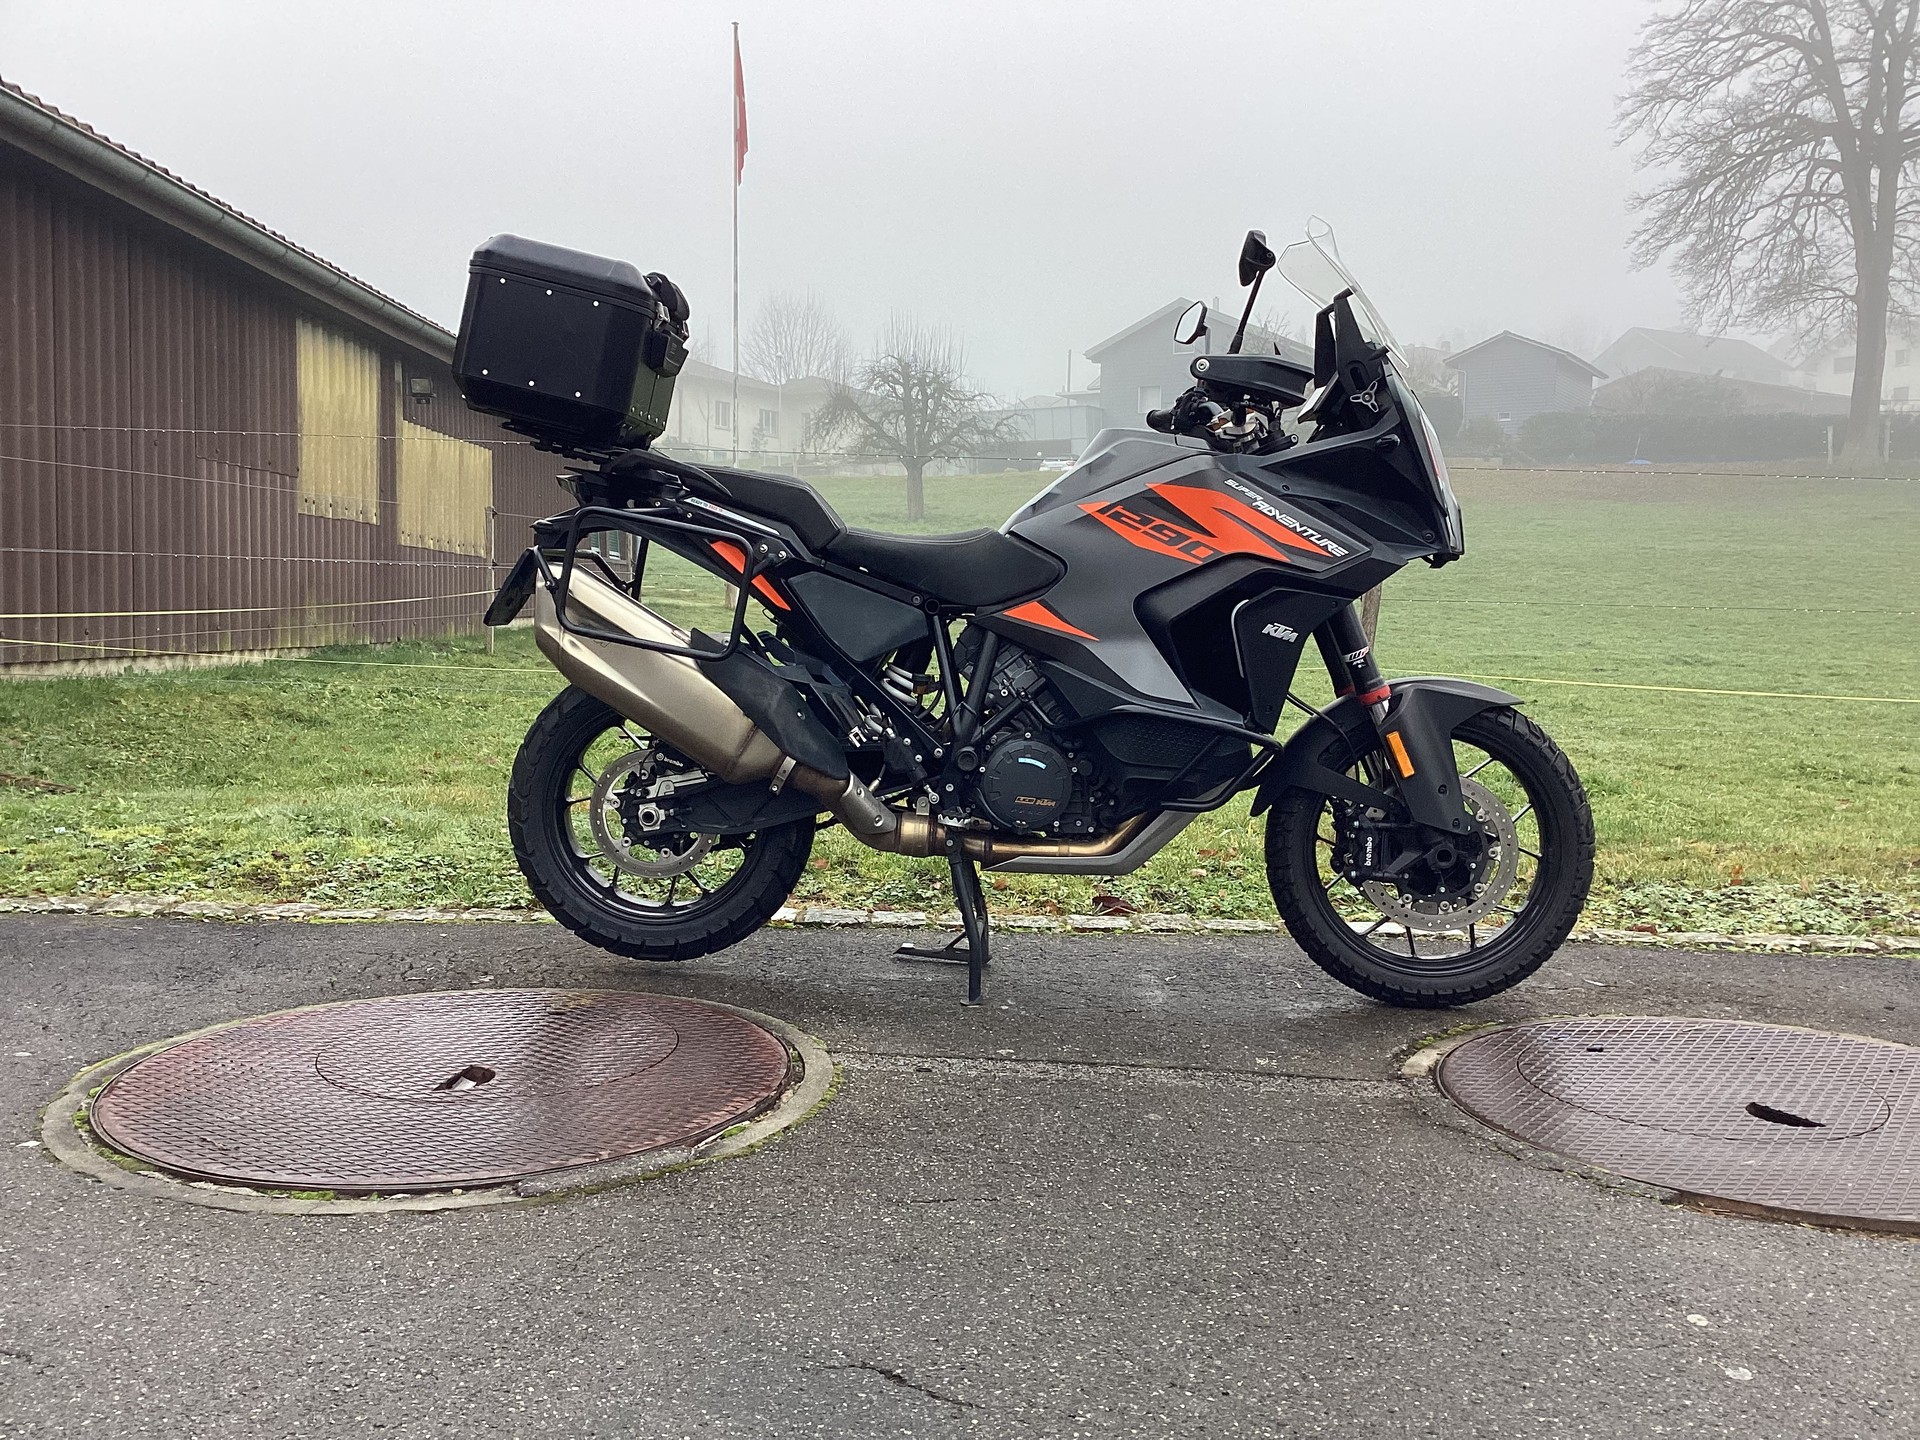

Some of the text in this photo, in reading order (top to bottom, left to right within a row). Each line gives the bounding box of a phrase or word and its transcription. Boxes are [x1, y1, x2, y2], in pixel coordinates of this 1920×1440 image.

[1224, 479, 1264, 501] SUPER
[1251, 500, 1349, 557] ADVENTURE
[1261, 622, 1299, 643] KTM
[1364, 836, 1373, 866] brembo
